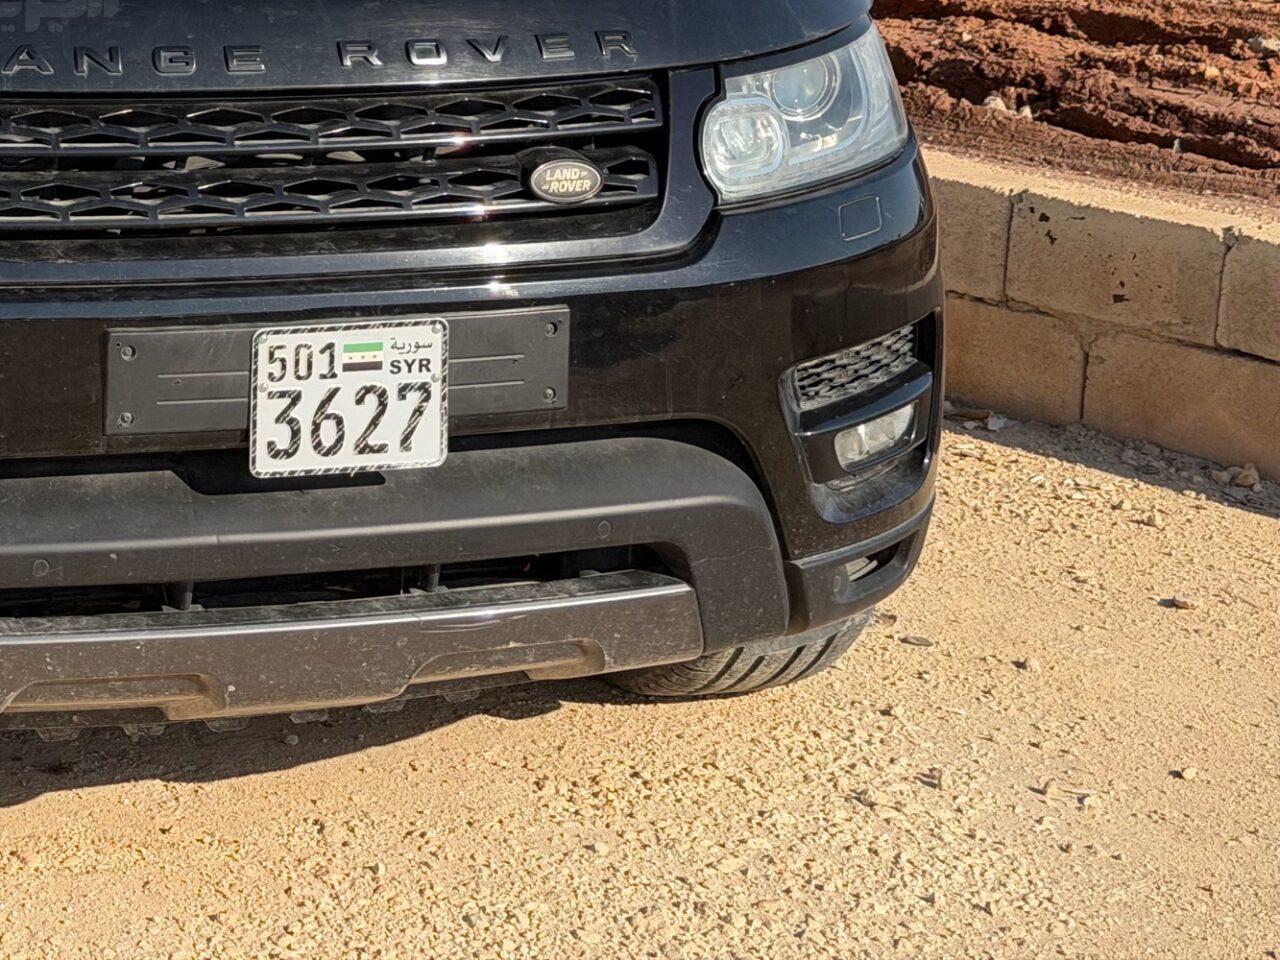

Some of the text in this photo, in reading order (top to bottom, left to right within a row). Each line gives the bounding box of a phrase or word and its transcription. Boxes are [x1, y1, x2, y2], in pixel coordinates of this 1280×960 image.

[336, 30, 640, 68] ROVER
[545, 168, 580, 181] LAND
[548, 180, 592, 193] ROVER
[390, 337, 434, 355] سورية
[267, 342, 339, 382] 501
[389, 357, 432, 374] SYR
[266, 381, 433, 461] 3627
